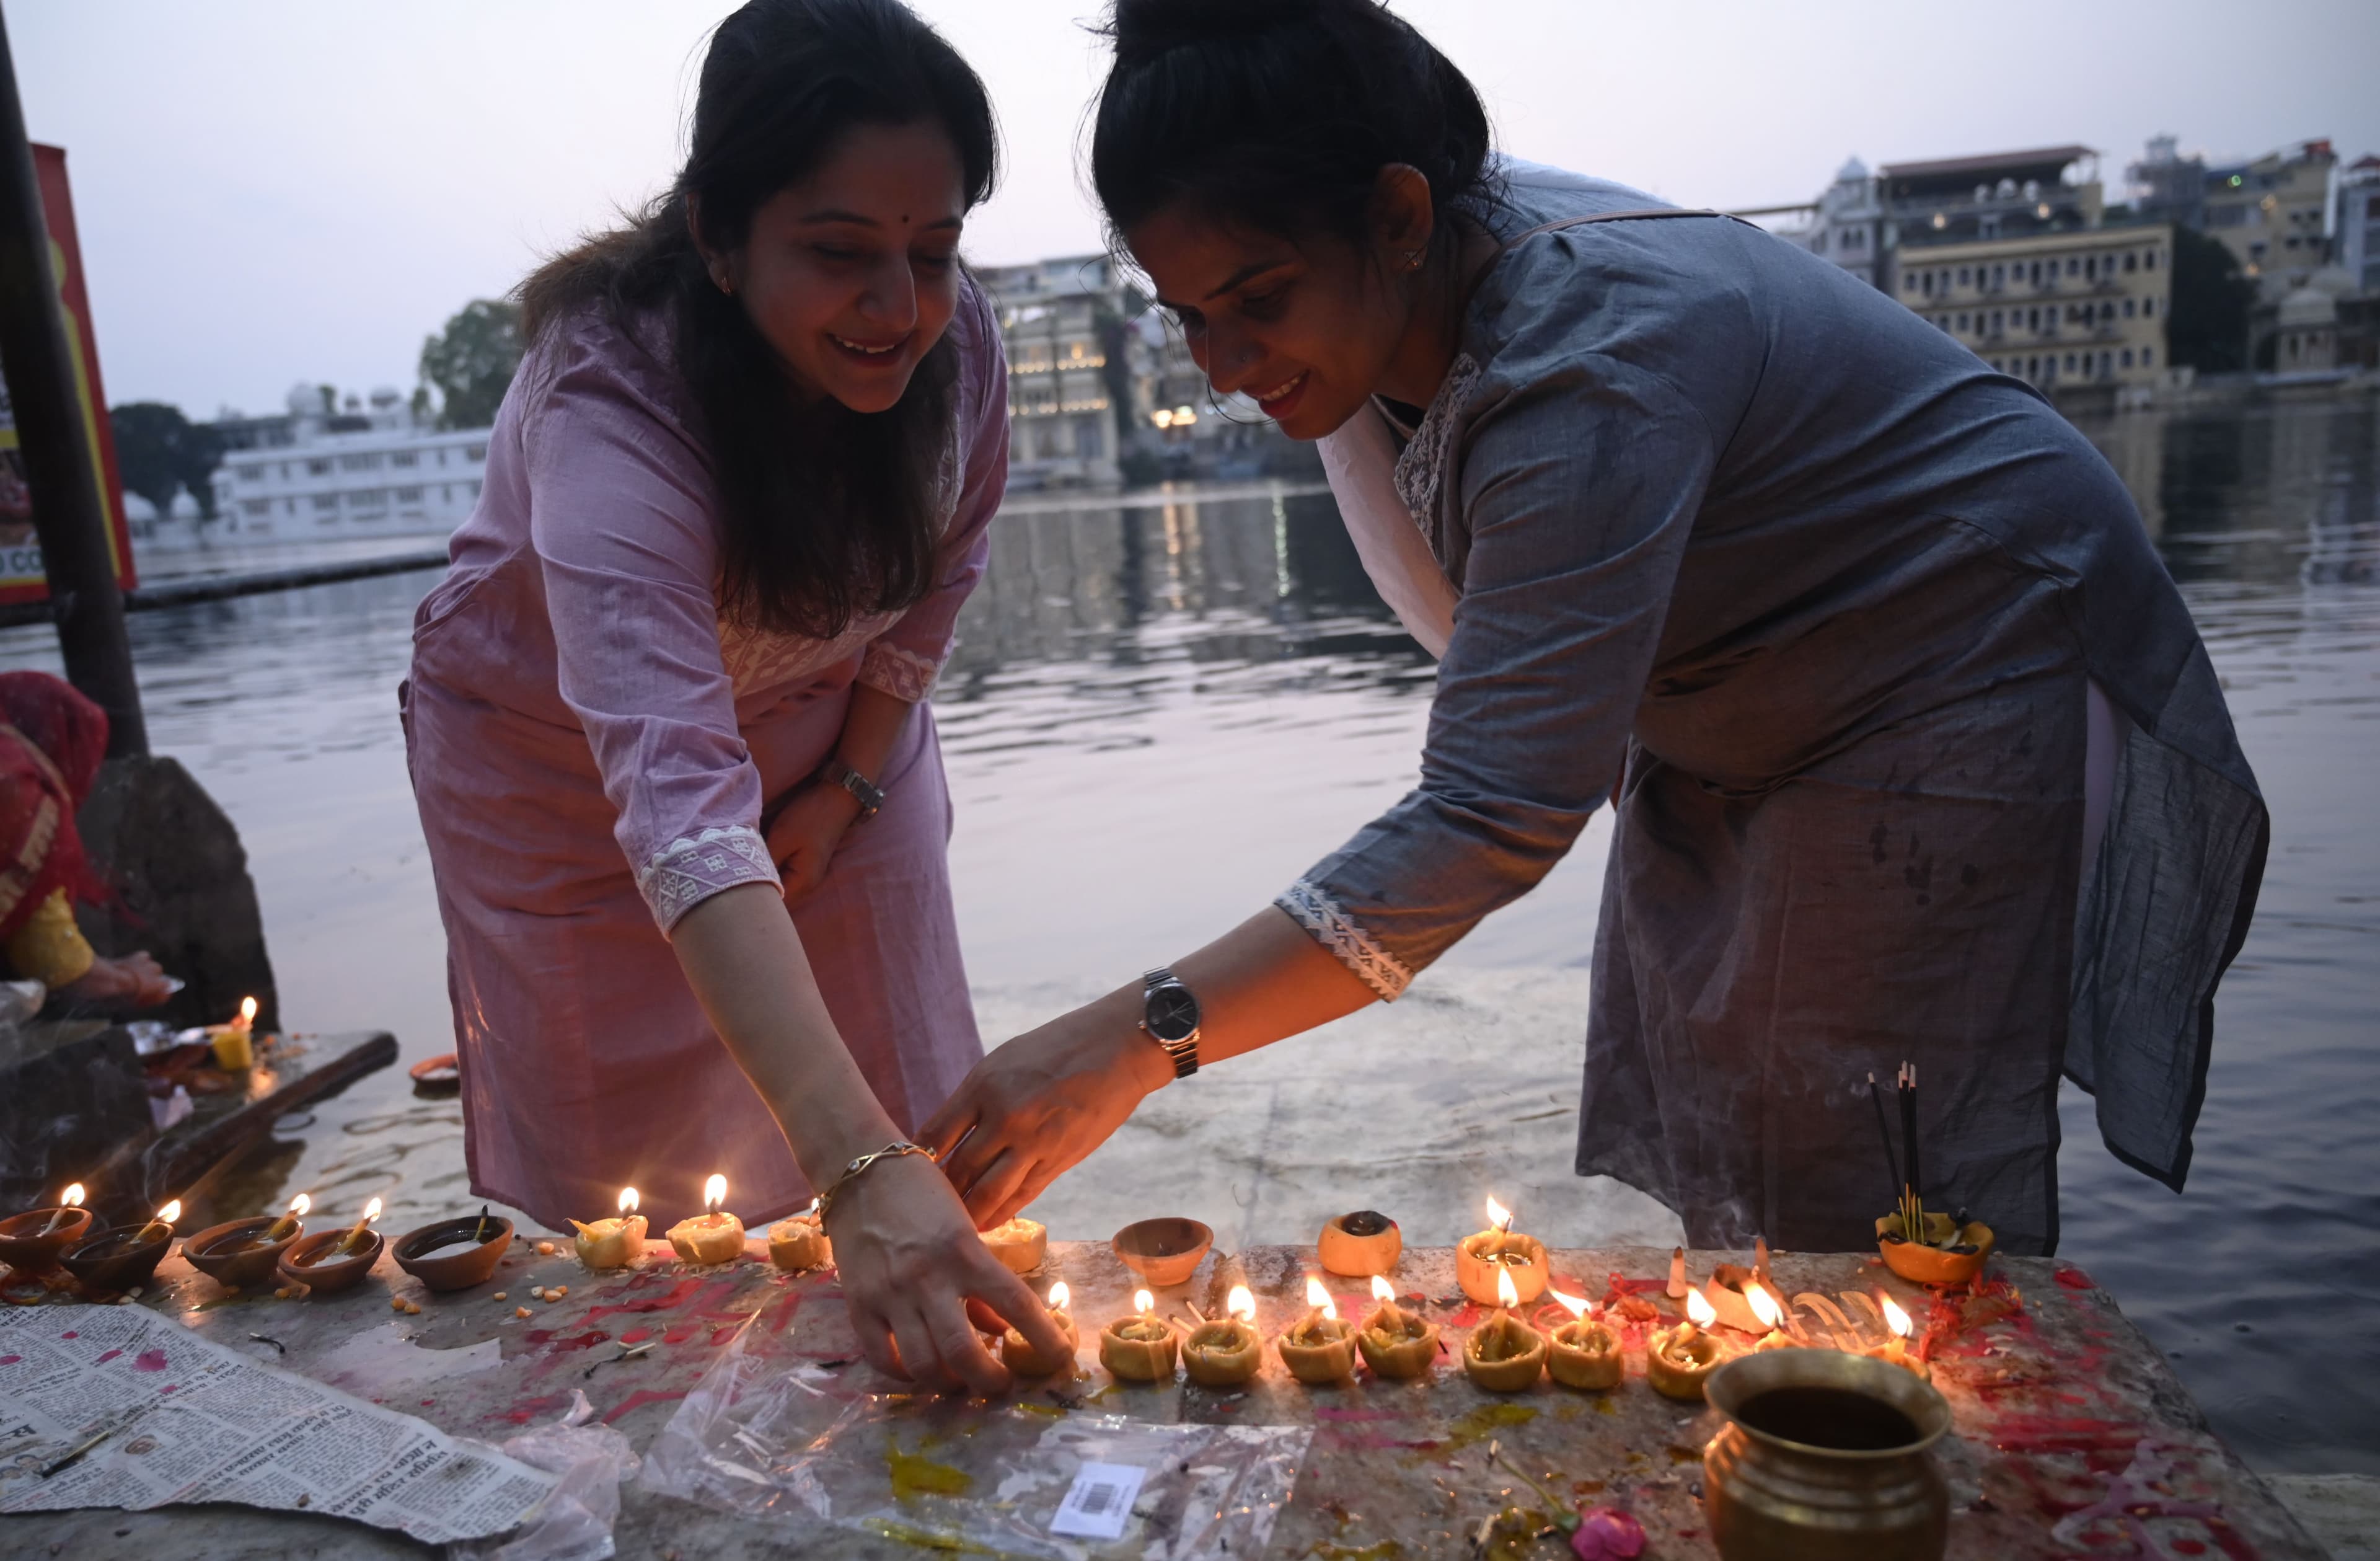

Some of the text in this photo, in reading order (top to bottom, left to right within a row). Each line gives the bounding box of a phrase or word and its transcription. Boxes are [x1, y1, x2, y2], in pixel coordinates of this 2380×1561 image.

[393, 1447, 425, 1470] यात्रा
[349, 1498, 374, 1515] पुरी
[373, 1477, 407, 1500] मंदिर
[407, 1451, 449, 1478] समिति
